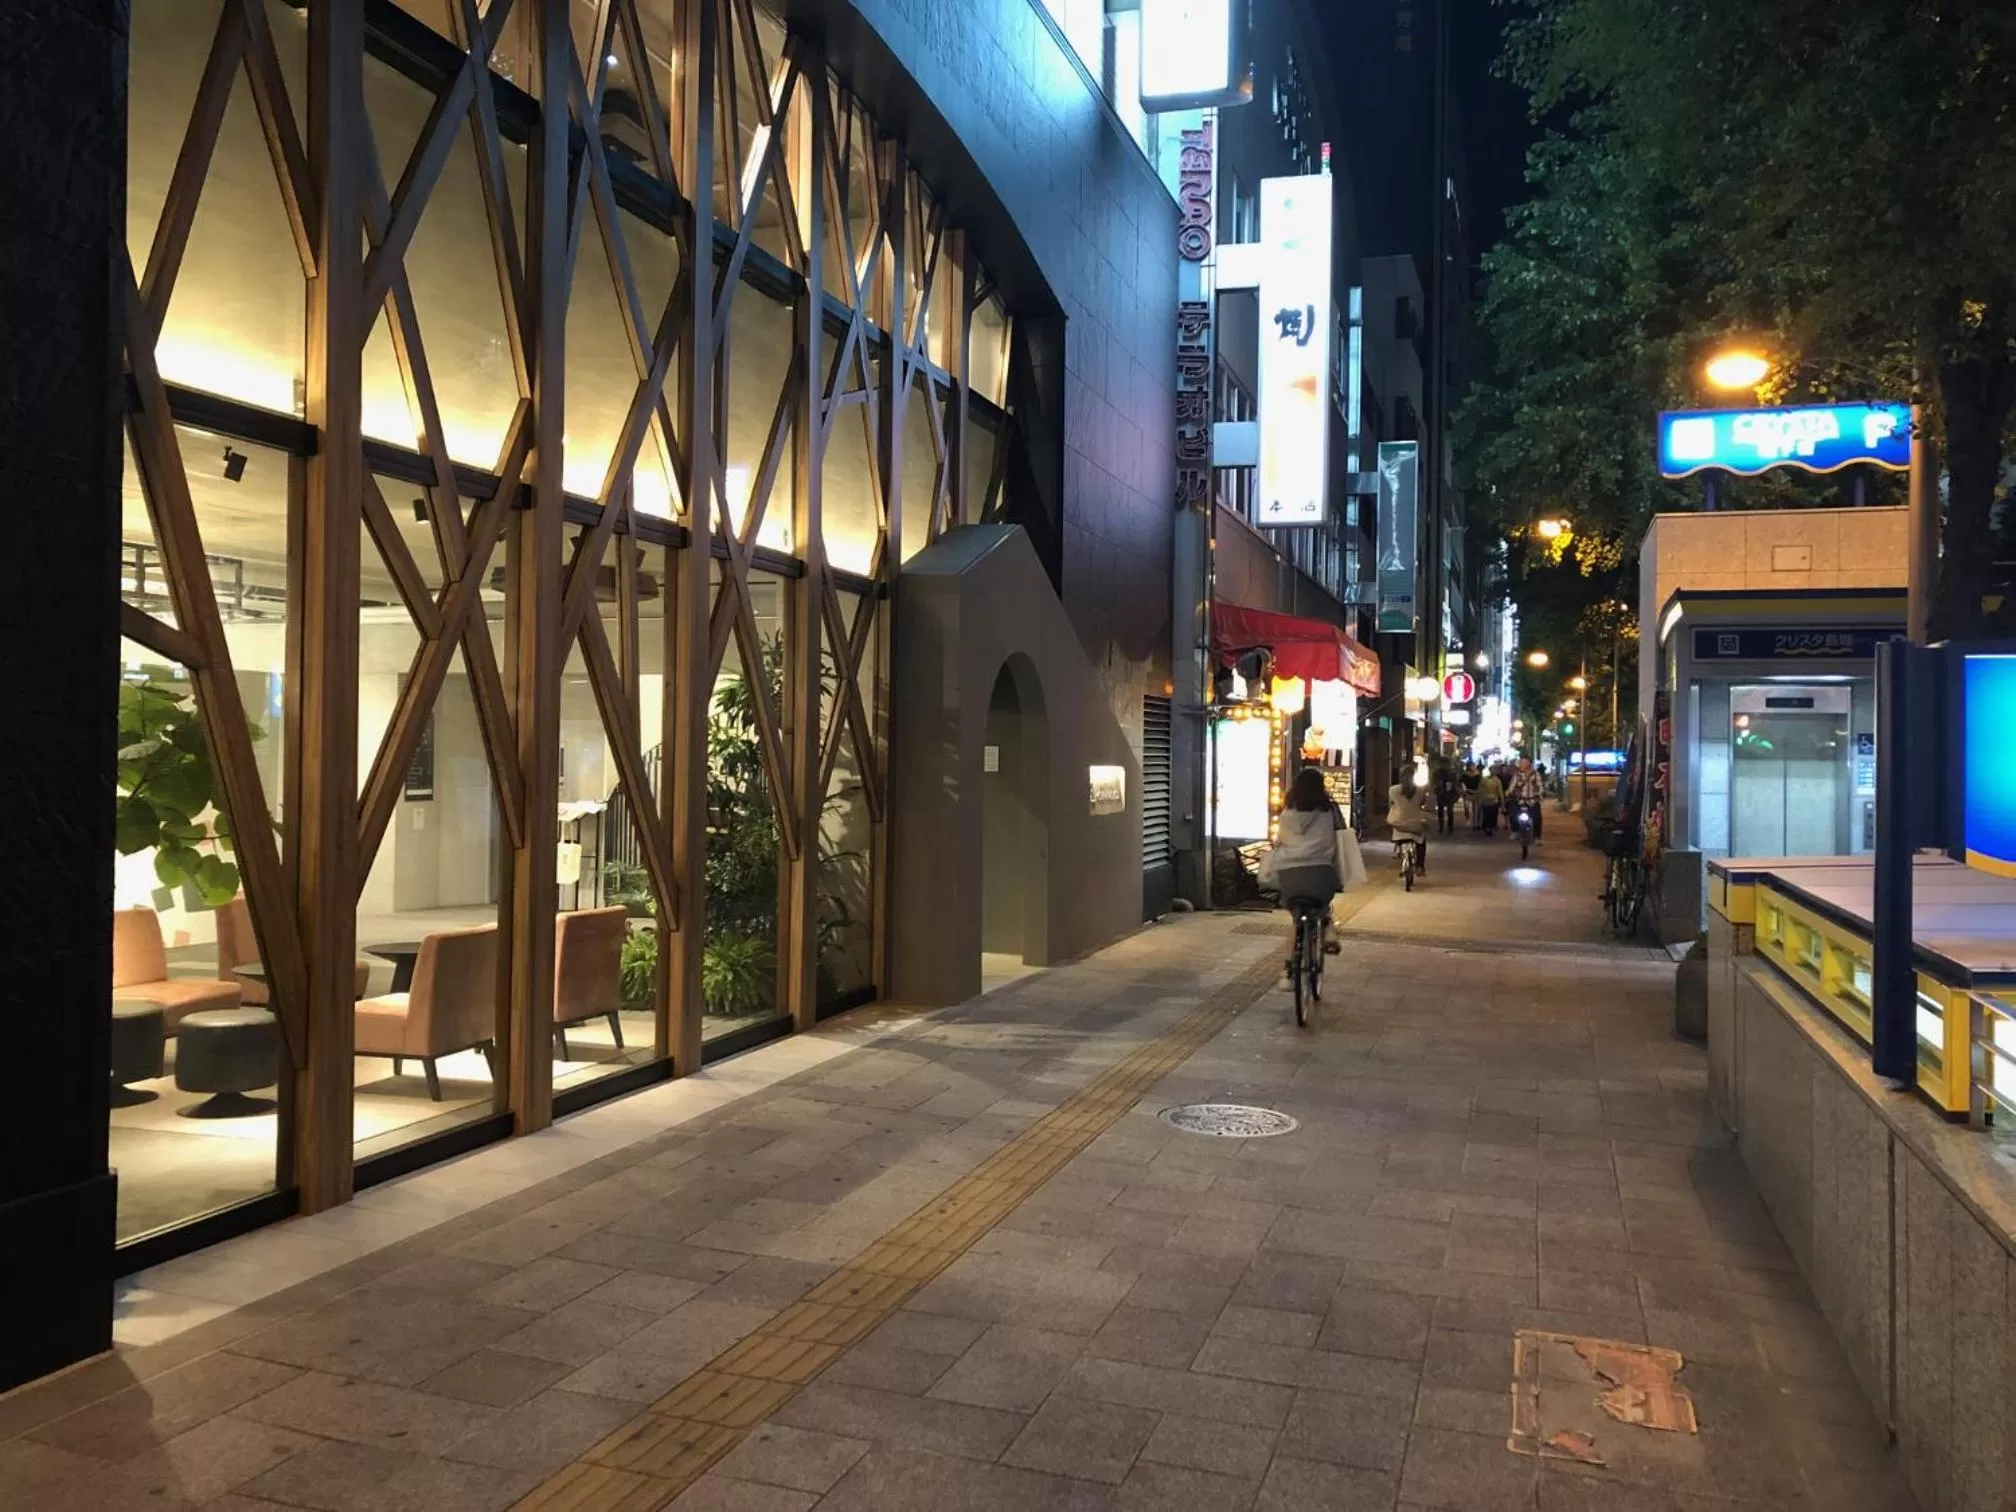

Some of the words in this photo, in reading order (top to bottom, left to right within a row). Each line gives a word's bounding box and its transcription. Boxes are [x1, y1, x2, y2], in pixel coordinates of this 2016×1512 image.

[1178, 121, 1214, 263] TERAO
[1175, 301, 1210, 502] テラオビル
